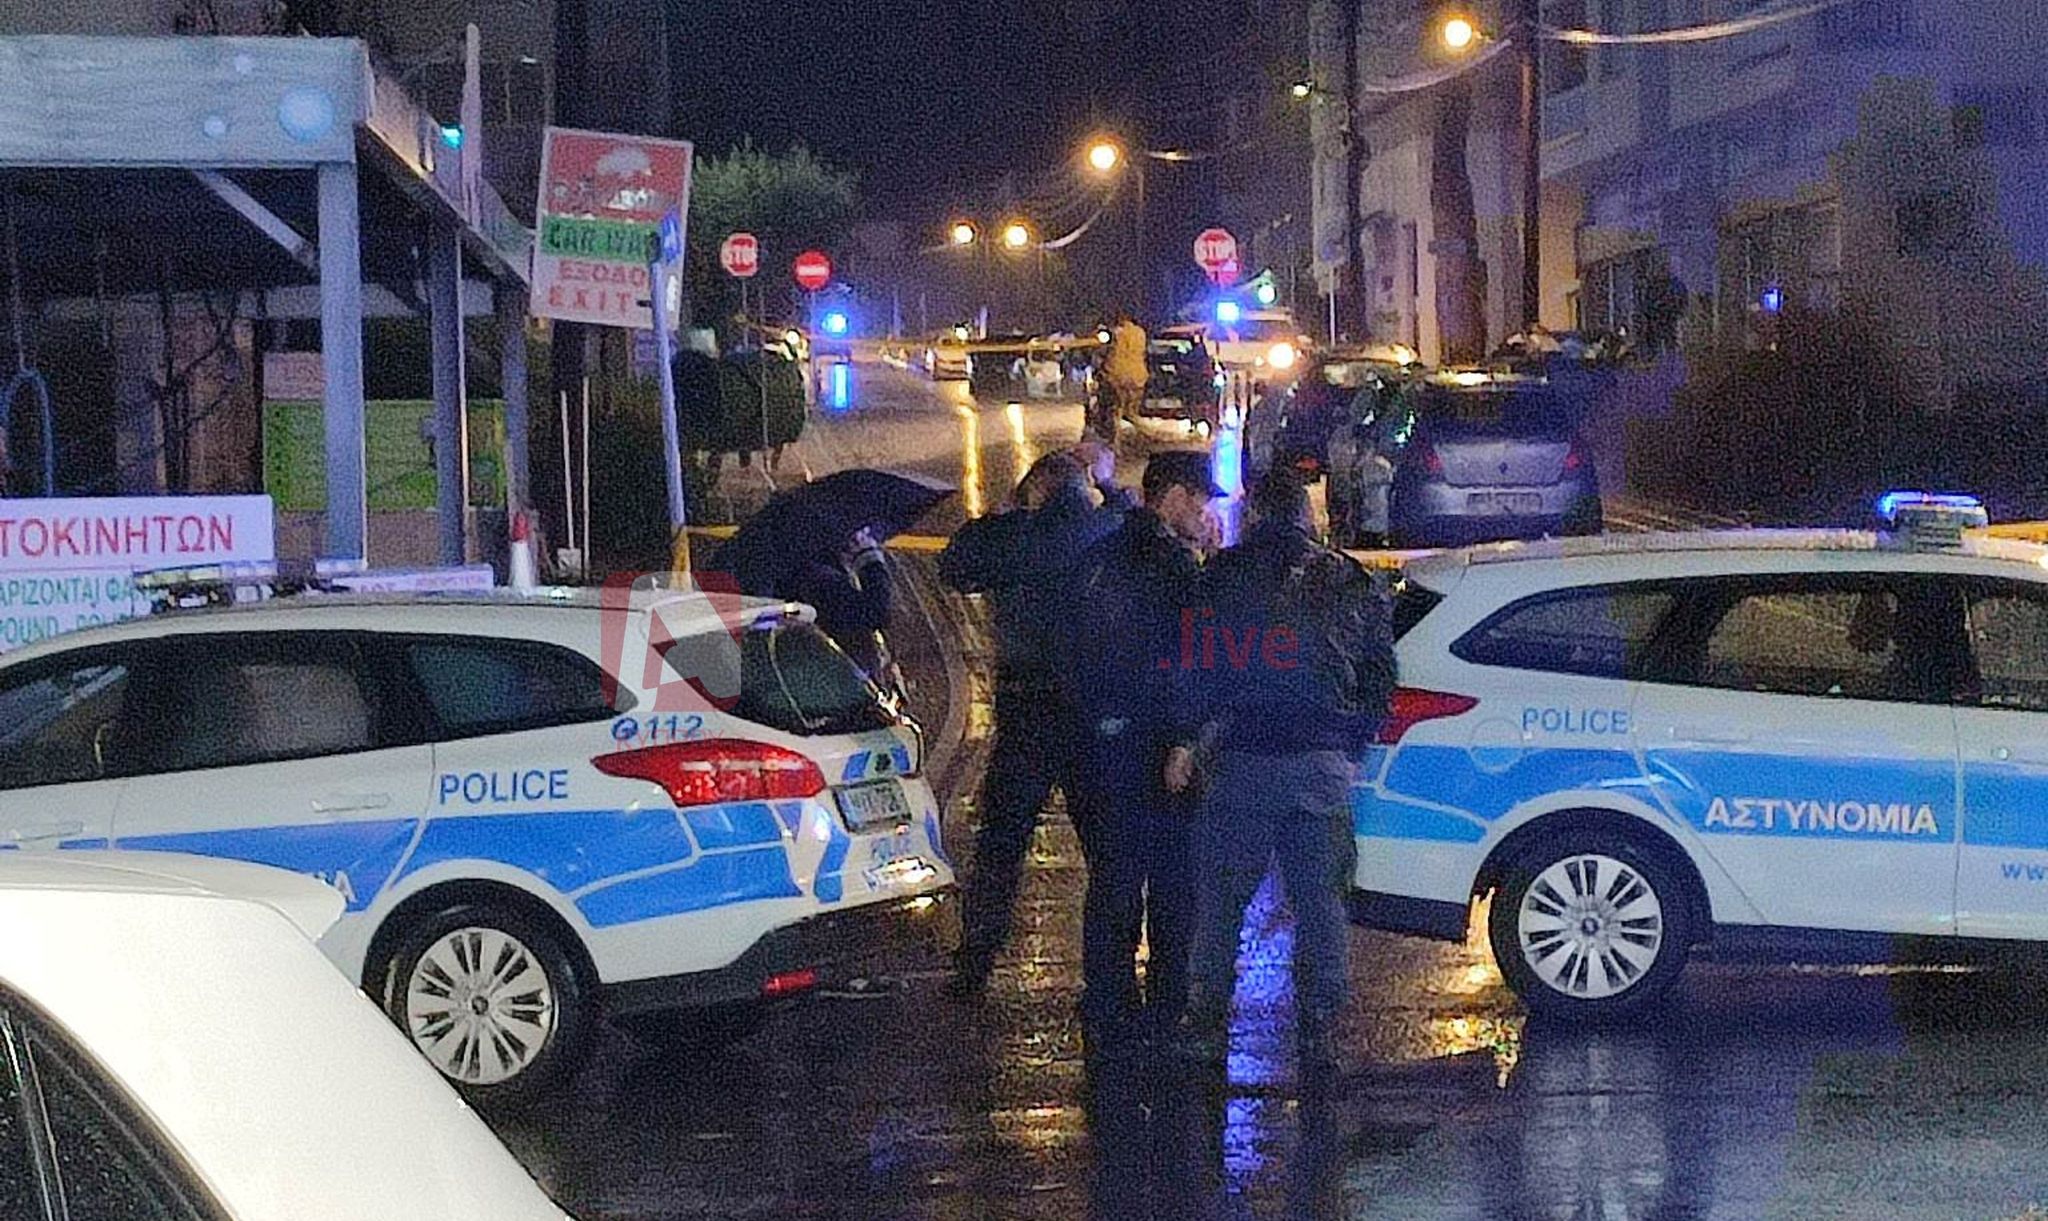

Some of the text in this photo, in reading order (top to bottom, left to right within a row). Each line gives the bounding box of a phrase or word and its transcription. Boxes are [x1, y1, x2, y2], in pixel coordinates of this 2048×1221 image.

[1522, 707, 1629, 735] POLICE
[440, 769, 569, 804] POLICE
[1704, 797, 1938, 835] ΑΣΤΥΝΟΜΙΑ
